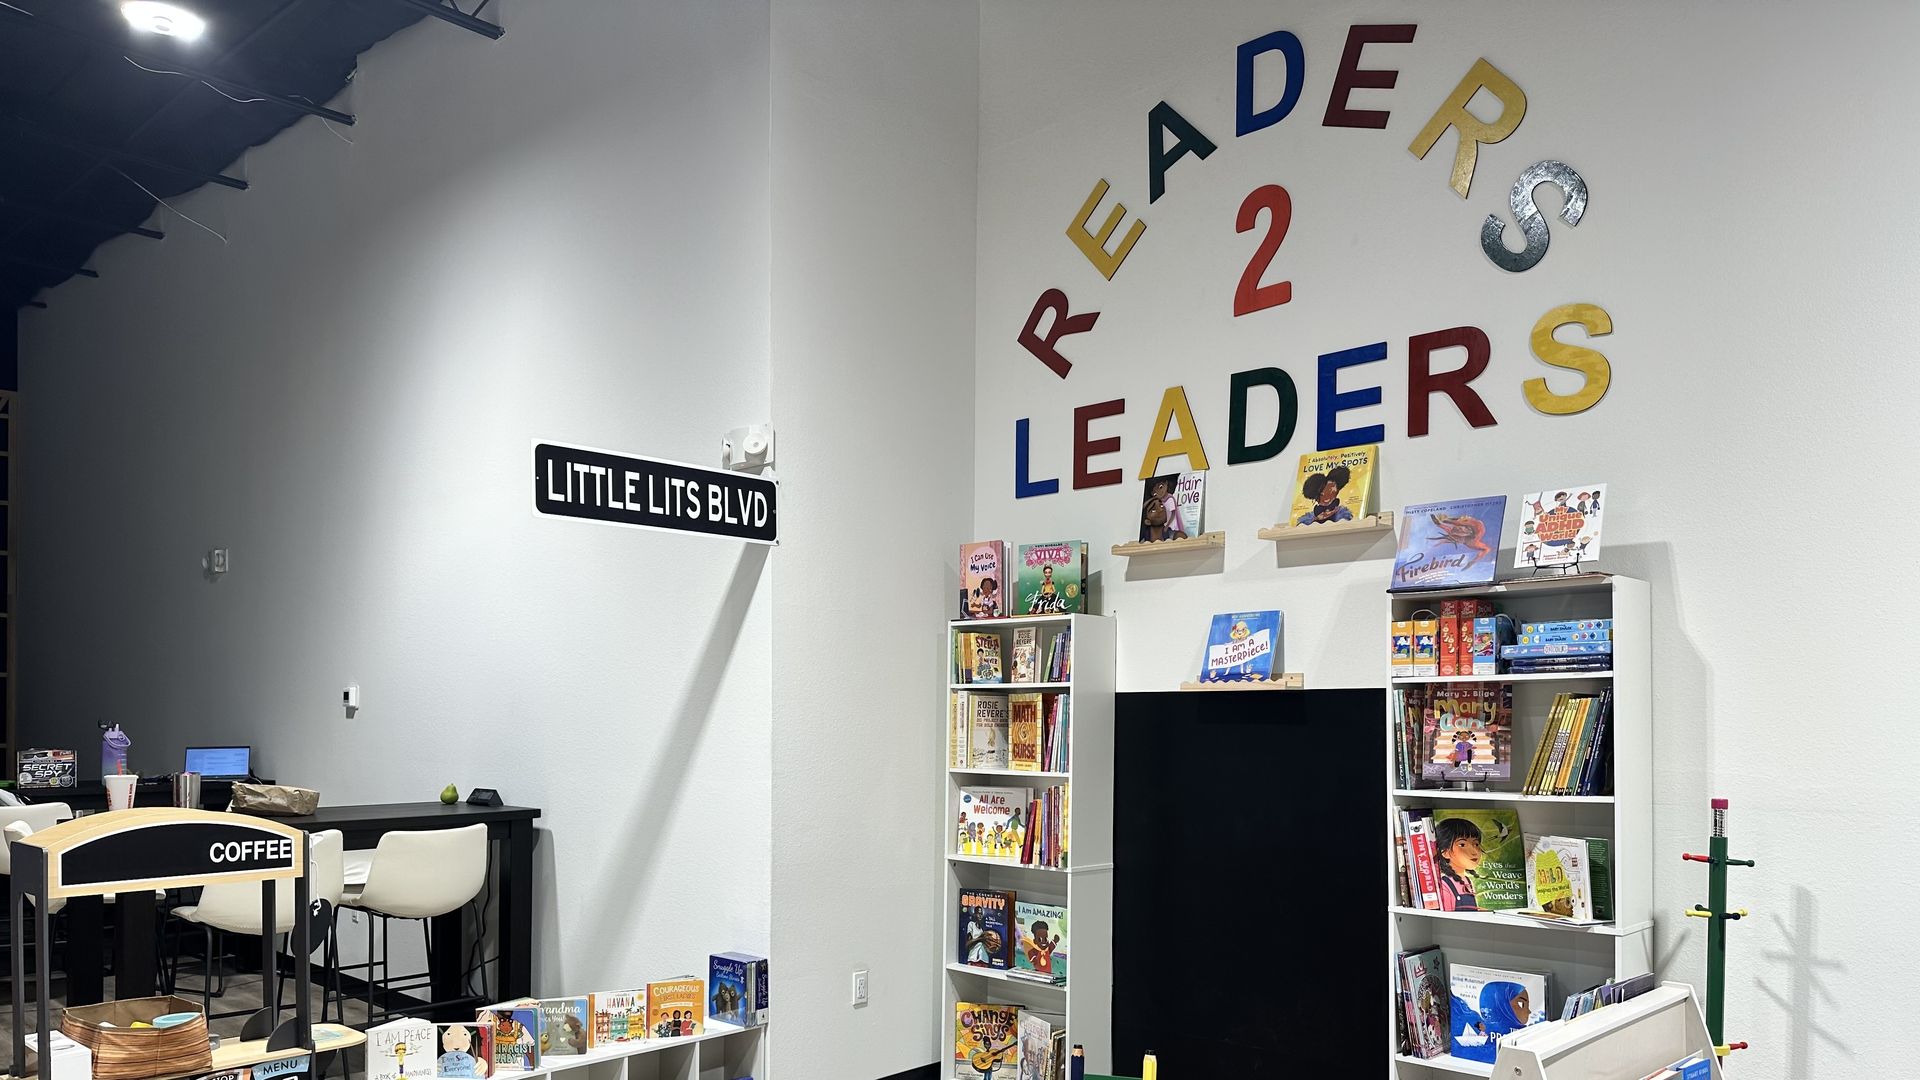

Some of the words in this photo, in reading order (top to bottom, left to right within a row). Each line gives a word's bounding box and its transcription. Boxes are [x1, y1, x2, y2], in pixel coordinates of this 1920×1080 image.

[1017, 24, 1588, 379] READERS
[1233, 185, 1292, 317] 2
[1015, 303, 1613, 499] LEADERS
[1303, 464, 1324, 473] LOVE
[1326, 462, 1339, 470] MY
[1341, 457, 1368, 468] SPOTS
[1178, 476, 1202, 491] Hair
[547, 459, 641, 511] LITTLE
[648, 474, 700, 519] LITS
[708, 484, 768, 528] BLVD
[1539, 512, 1583, 523] Unique
[1535, 519, 1585, 533] ADHD
[1540, 530, 1576, 541] World
[971, 564, 980, 573] My
[1396, 552, 1465, 582] Firebird
[1025, 591, 1072, 612] Frida
[1248, 638, 1255, 647] A
[1473, 690, 1495, 698] Blige
[977, 701, 999, 709] ROSIE
[1013, 704, 1036, 722] MATH
[1014, 743, 1036, 759] CURSE
[23, 763, 72, 771] SECRET
[34, 770, 62, 778] SPY
[979, 794, 989, 804] All
[991, 795, 1005, 805] Are
[974, 805, 1010, 815] Welcome
[210, 839, 292, 863] COFFEE
[1482, 860, 1503, 870] Eyes
[1492, 870, 1522, 879] Weave
[1486, 881, 1520, 890] World's
[1483, 891, 1524, 900] Wonders
[961, 894, 1005, 910] GRAVITY
[1018, 905, 1021, 913] I
[1021, 906, 1032, 915] Am
[653, 985, 700, 996] COURAGEOUS
[539, 1002, 582, 1014] randma
[606, 996, 635, 1008] HAVANA
[376, 1032, 381, 1046] I
[385, 1031, 401, 1044] AM
[403, 1028, 431, 1043] PEACE
[971, 1022, 1009, 1041] Sings
[496, 1043, 533, 1054] IRACIST
[263, 1060, 298, 1075] MENU
